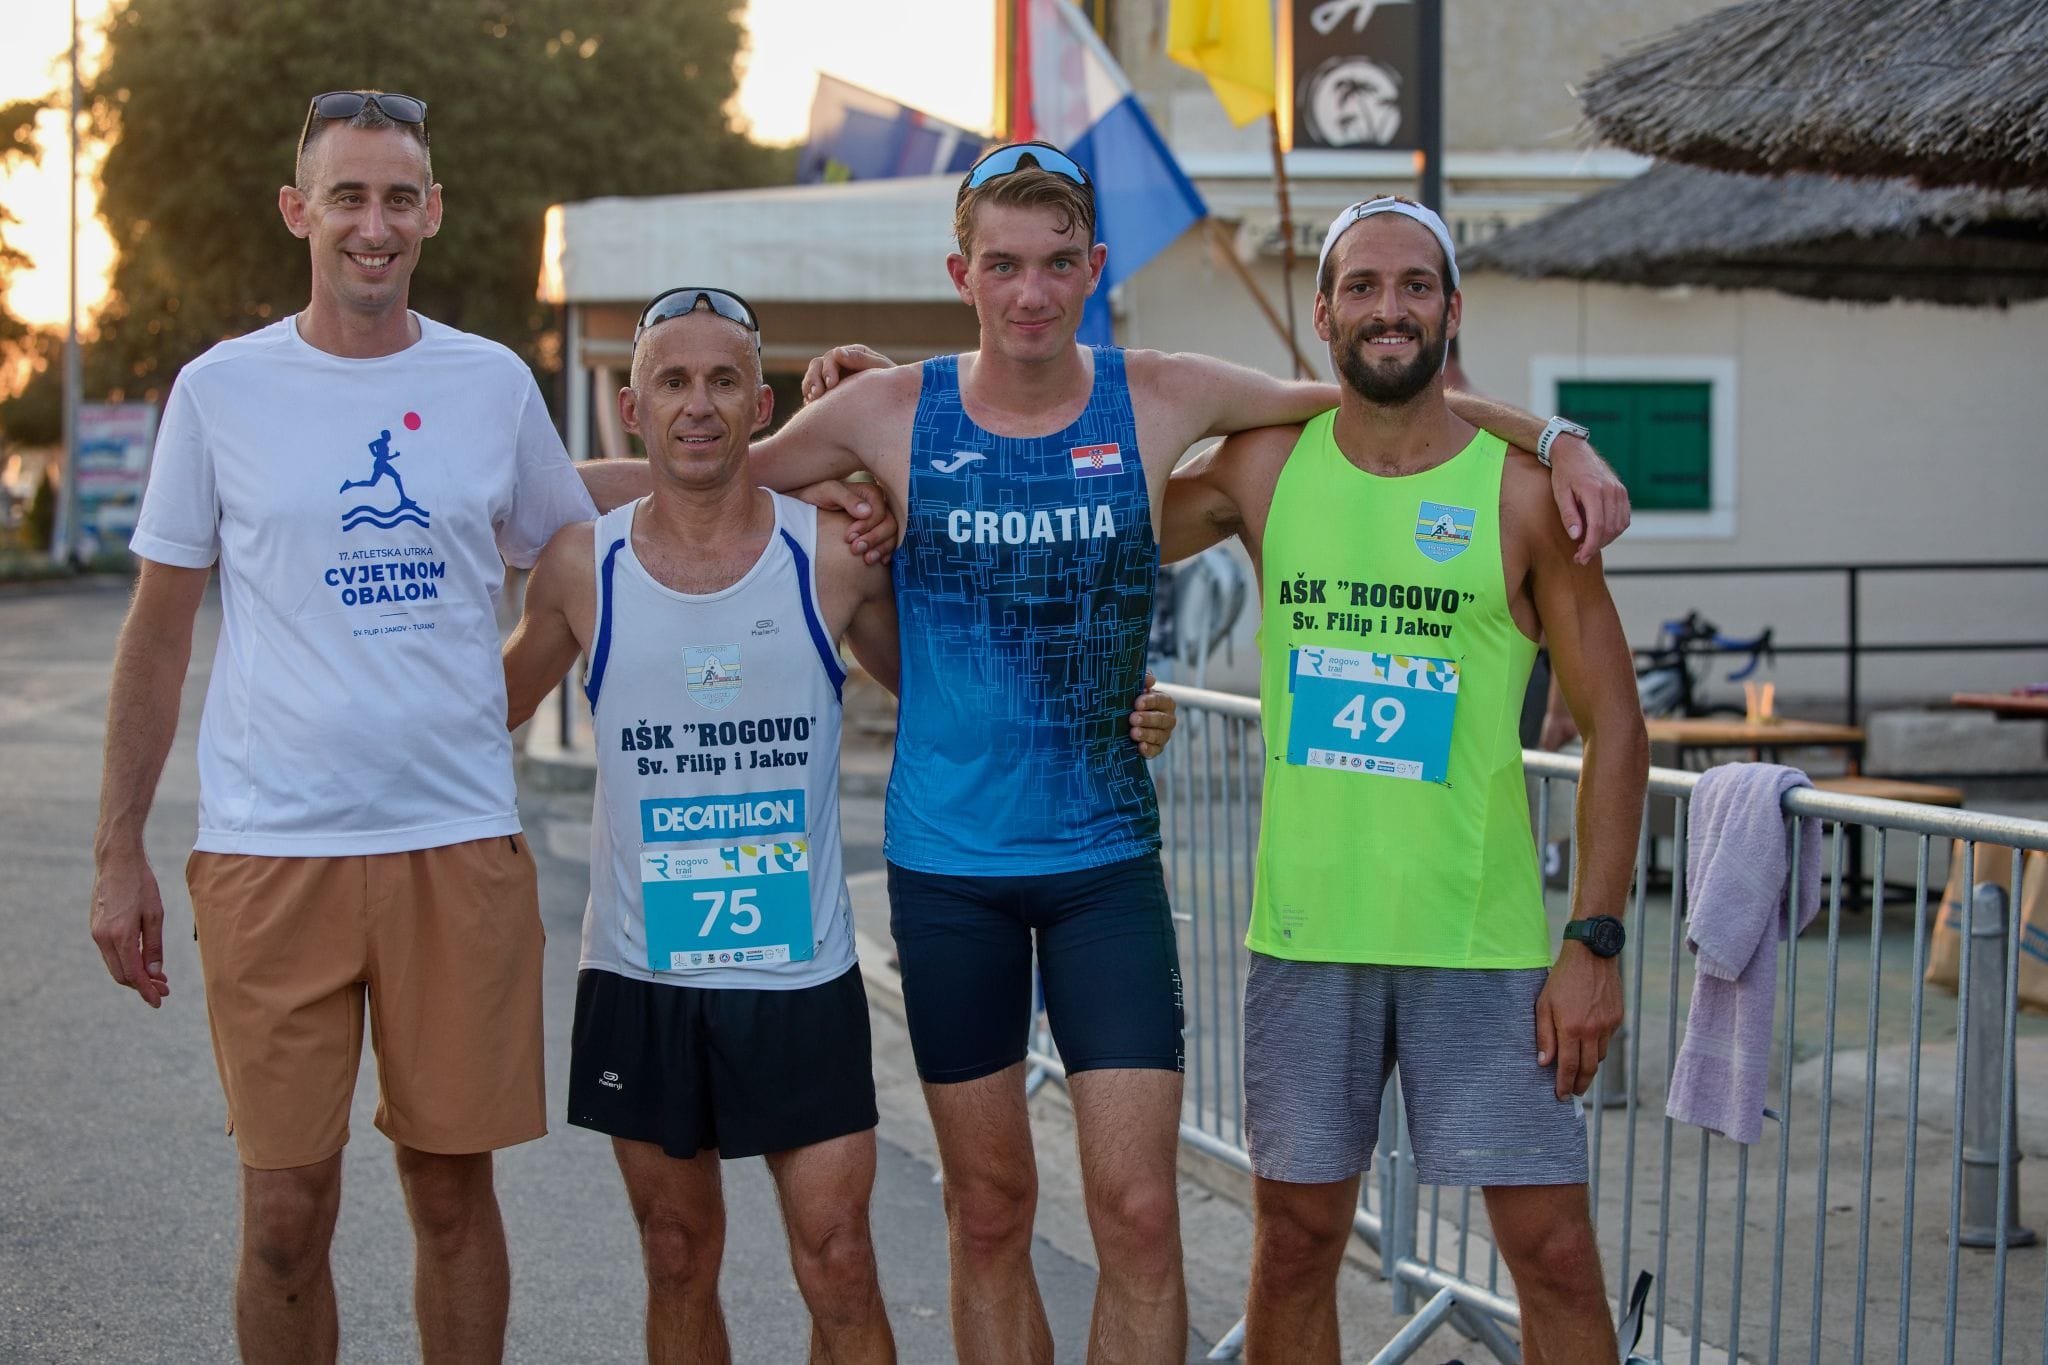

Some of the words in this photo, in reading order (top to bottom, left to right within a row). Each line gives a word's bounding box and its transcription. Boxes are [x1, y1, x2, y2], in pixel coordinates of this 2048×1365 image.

[948, 504, 1116, 545] CROATIA
[338, 552, 350, 561] 17.
[352, 548, 402, 560] ATLETSKA
[404, 547, 434, 557] UTRKA
[324, 561, 446, 586] CVJETNOM
[1279, 572, 1327, 604] AŠK
[341, 582, 439, 606] OBALOM
[1292, 611, 1320, 630] Sv.
[1326, 612, 1373, 636] Filip
[1380, 615, 1388, 634] i
[1394, 616, 1453, 639] Jakov
[1332, 693, 1406, 743] 49
[621, 719, 675, 751] AŠK
[637, 757, 668, 776] Sv.
[675, 752, 727, 776] Filip
[734, 751, 742, 770] i
[749, 749, 809, 769] Jakov
[652, 799, 794, 832] DECATHLON
[692, 888, 762, 937] 75
